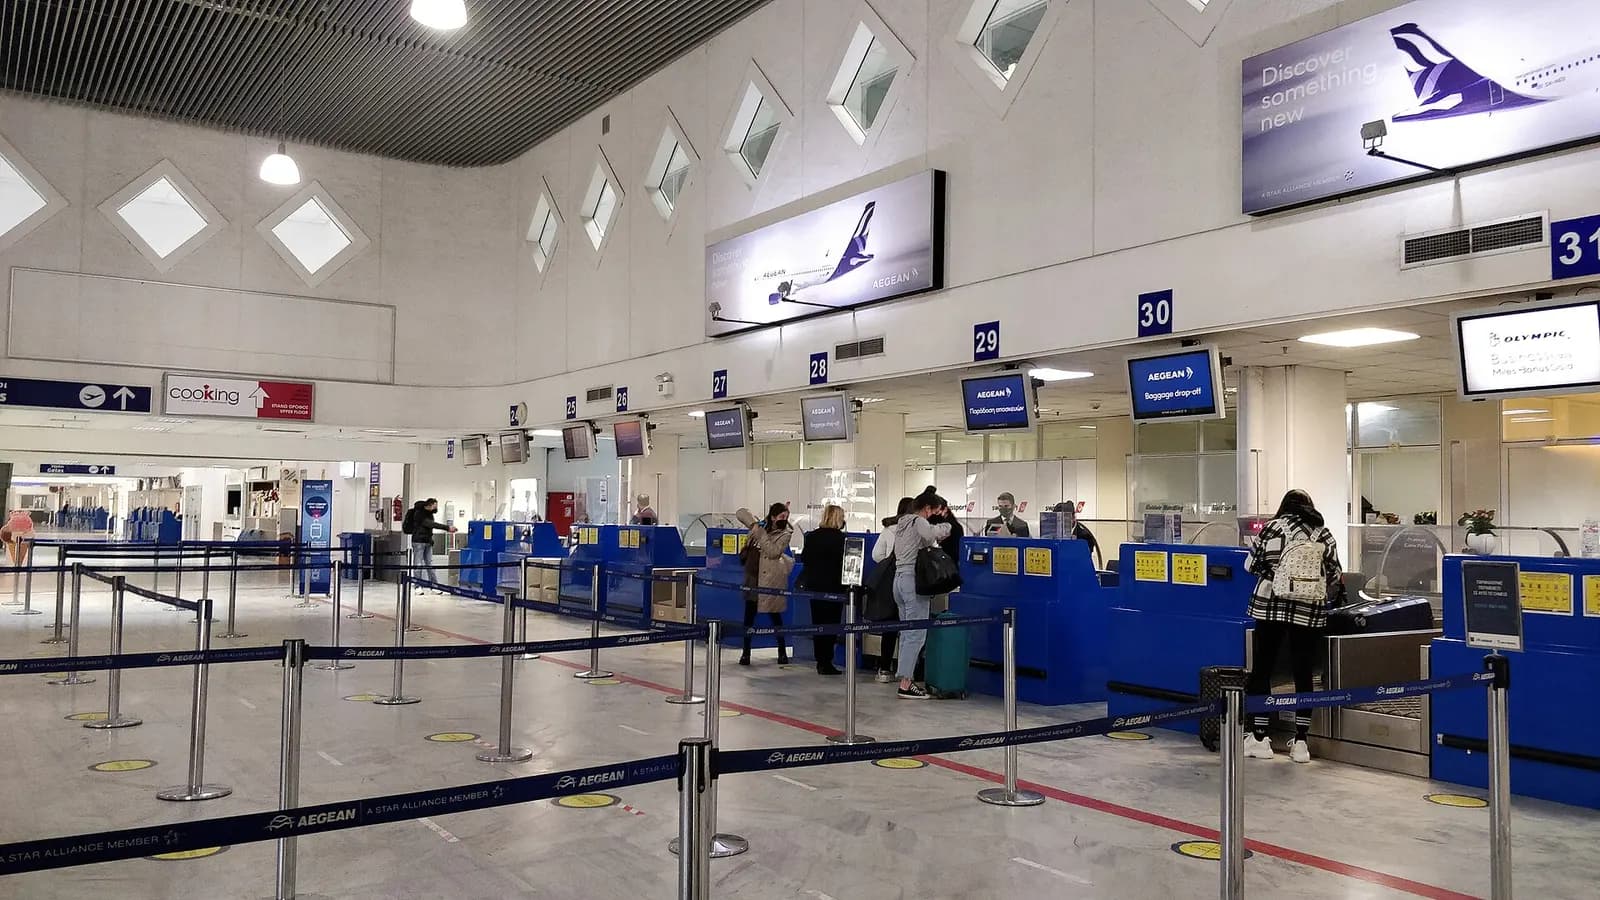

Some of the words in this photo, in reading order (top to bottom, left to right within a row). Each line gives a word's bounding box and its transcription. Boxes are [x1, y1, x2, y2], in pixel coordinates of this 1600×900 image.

[1261, 46, 1352, 87] Discover
[1261, 62, 1377, 109] something
[1261, 107, 1304, 132] new
[872, 271, 910, 289] AEGEAN
[1140, 299, 1170, 328] 30
[975, 329, 998, 353] 29
[1504, 330, 1566, 343] OLYMPIC
[811, 360, 827, 379] 28
[1148, 369, 1185, 381] AEGEAN
[713, 375, 726, 393] 27
[170, 384, 239, 405] cooking
[617, 394, 627, 407] 26
[977, 389, 1005, 399] AEGEAN
[1145, 391, 1174, 401] Baggage
[1174, 387, 1202, 398] drop-off
[567, 401, 576, 414] 25
[172, 653, 205, 662] AEGEAN
[1276, 697, 1297, 706] AEGEAN
[1125, 715, 1151, 726] AEGEAN
[973, 736, 1006, 746] AEGEAN
[786, 751, 825, 763] AEGEAN
[578, 770, 625, 787] AEGEAN
[633, 769, 638, 777] A
[640, 766, 659, 775] STAR
[297, 808, 357, 828] AEGEAN
[367, 807, 374, 815] A
[375, 803, 400, 815] STAR
[402, 796, 448, 810] ALLIANCE
[449, 790, 489, 803] MEMBER
[9, 850, 41, 863] STAR
[44, 841, 104, 858] ALLIANCE
[107, 835, 159, 849] MEMBER
